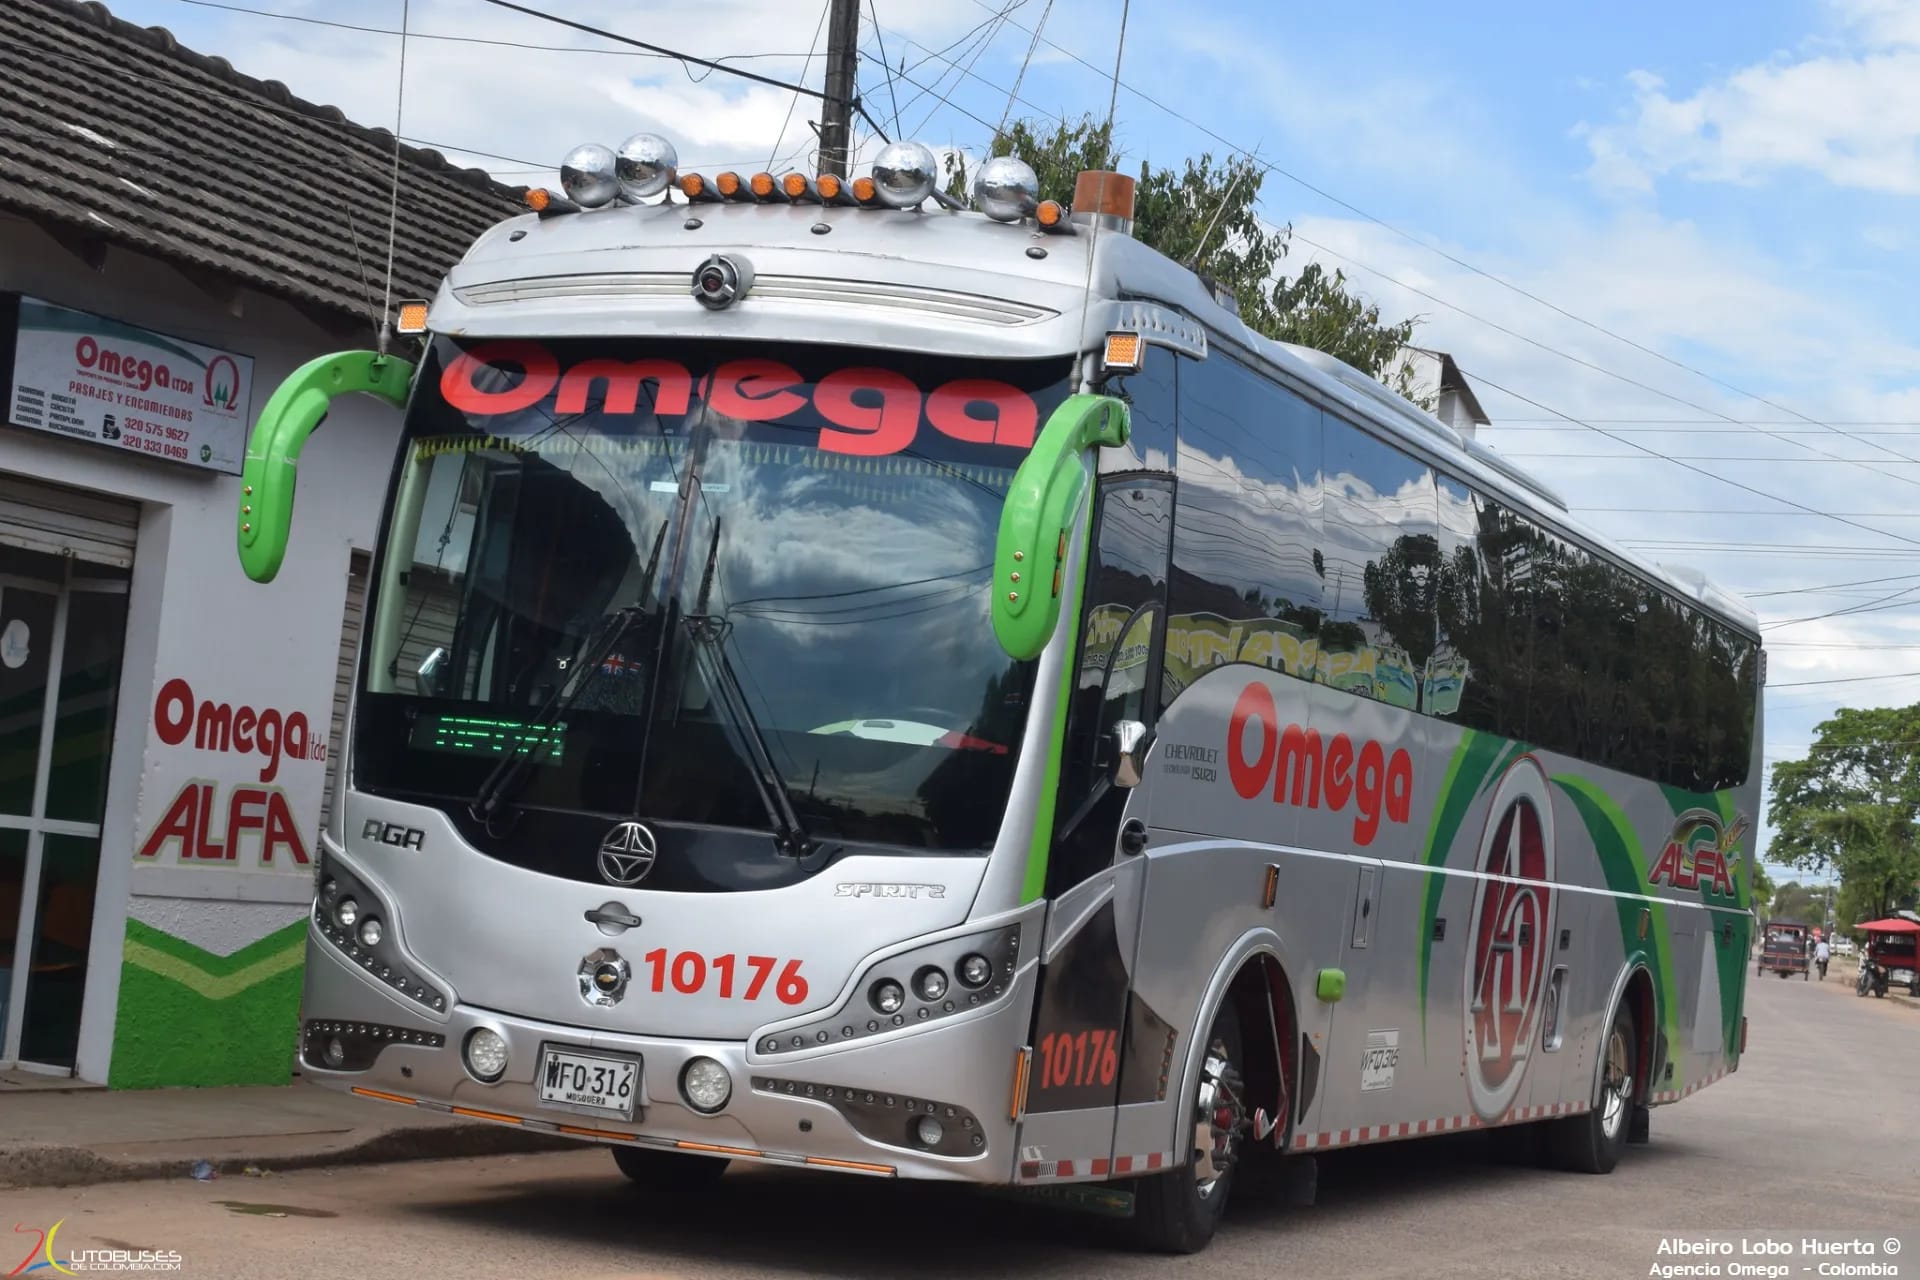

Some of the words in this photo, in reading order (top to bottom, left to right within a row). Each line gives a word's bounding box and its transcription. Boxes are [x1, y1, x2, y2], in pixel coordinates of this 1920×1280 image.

[76, 336, 170, 392] Omega
[69, 381, 114, 402] PASAJES
[117, 393, 123, 404] Y
[125, 395, 193, 422] ENCOMIENDAS
[439, 341, 1038, 456] Omega
[123, 435, 141, 449] 320
[144, 439, 161, 453] 333
[164, 444, 188, 460] 0469
[125, 417, 143, 432] 320
[146, 422, 163, 437] 575
[166, 427, 189, 442] 9627
[154, 678, 308, 783] Omega
[1165, 743, 1219, 764] CHEVROLET
[1191, 766, 1217, 783] ISUZU
[1227, 681, 1412, 847] Omega
[138, 782, 311, 865] ALFA
[361, 819, 426, 852] AGA
[834, 882, 925, 899] SPIRIT
[1648, 841, 1735, 897] ALFA
[645, 947, 809, 1006] 10176
[1041, 1029, 1118, 1090] 10176
[566, 1091, 606, 1106] MOSQUERA
